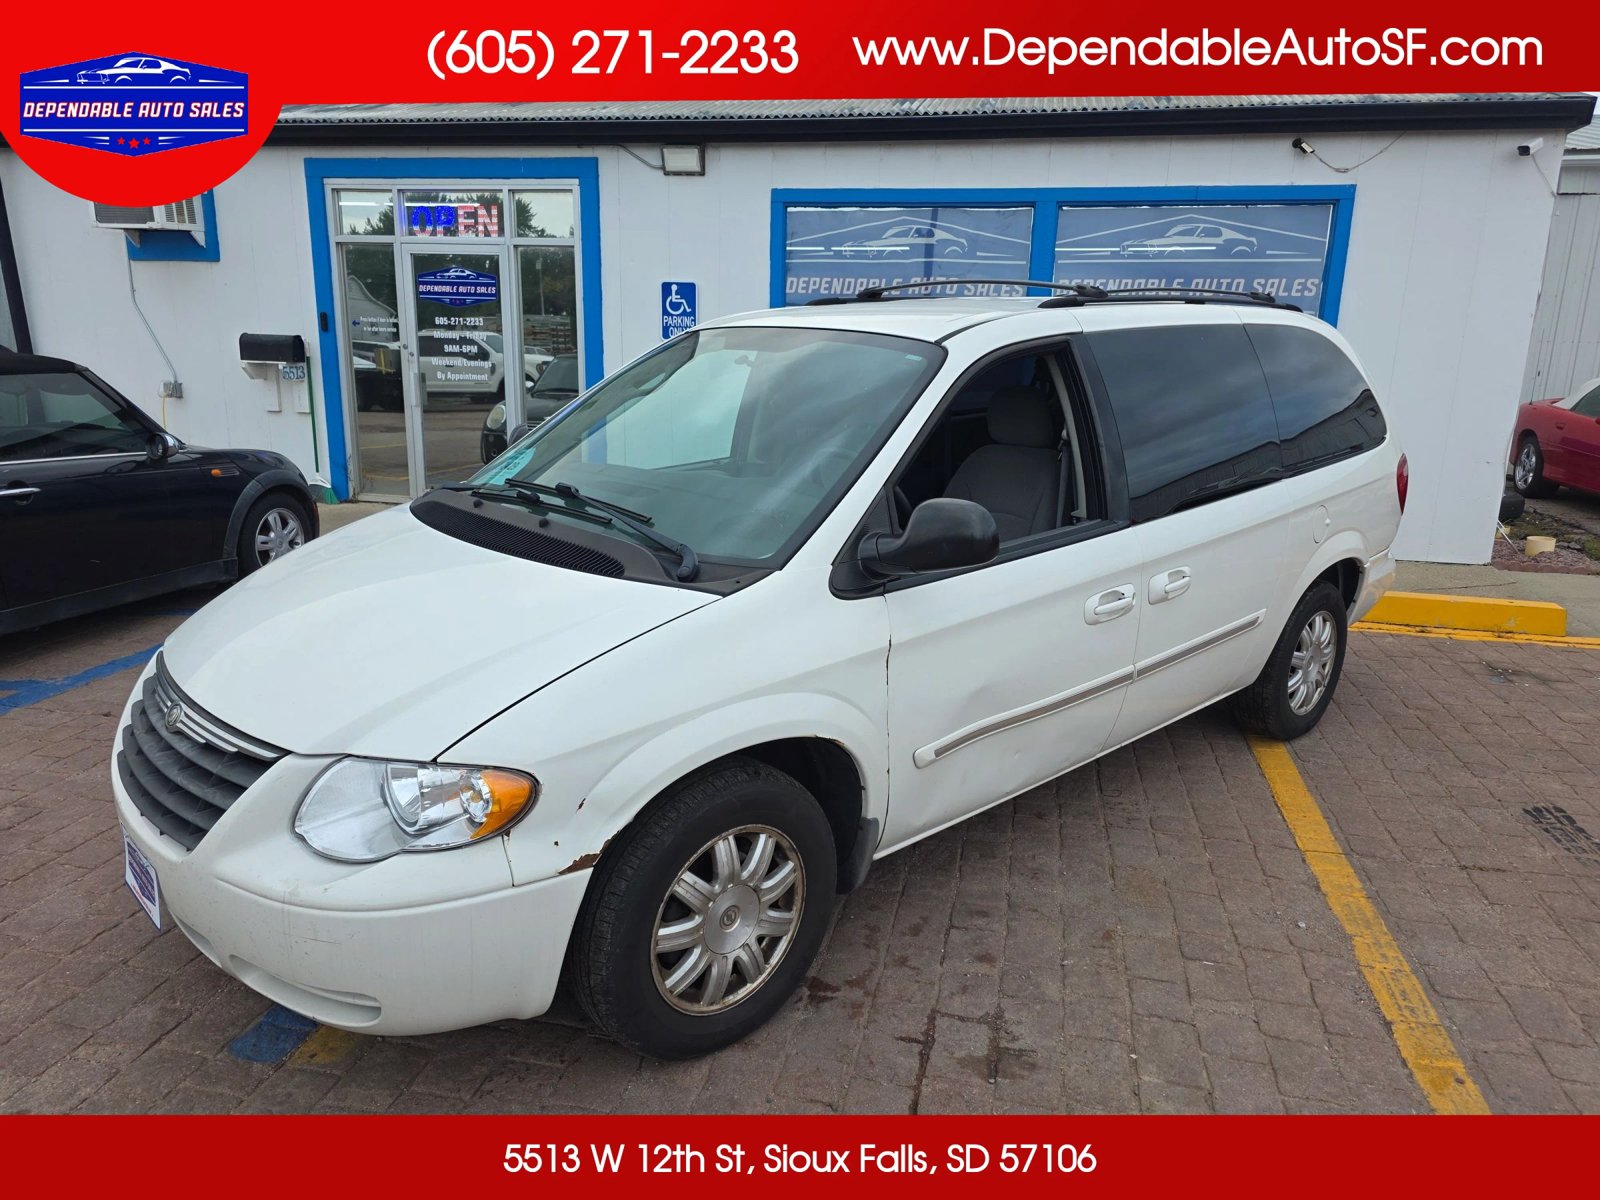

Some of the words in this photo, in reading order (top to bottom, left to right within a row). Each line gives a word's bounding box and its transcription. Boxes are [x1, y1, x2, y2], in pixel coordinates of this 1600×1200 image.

[412, 205, 499, 237] OPEN
[418, 284, 458, 293] DEPENDABLE
[476, 286, 496, 294] SALES
[908, 277, 959, 295] AUTO
[963, 280, 1024, 297] SALES
[1188, 278, 1245, 296] AUTO
[1253, 278, 1320, 297] SALES
[434, 316, 484, 326] 605-271-2233
[663, 315, 695, 326] PARKING
[433, 331, 460, 341] Monday
[668, 327, 689, 337] ONL
[443, 344, 478, 353] 9AM-6PM
[431, 357, 492, 369] Weekend/Evenings
[282, 365, 306, 380] 5513
[437, 371, 446, 380] By
[447, 371, 489, 381] Appointment
